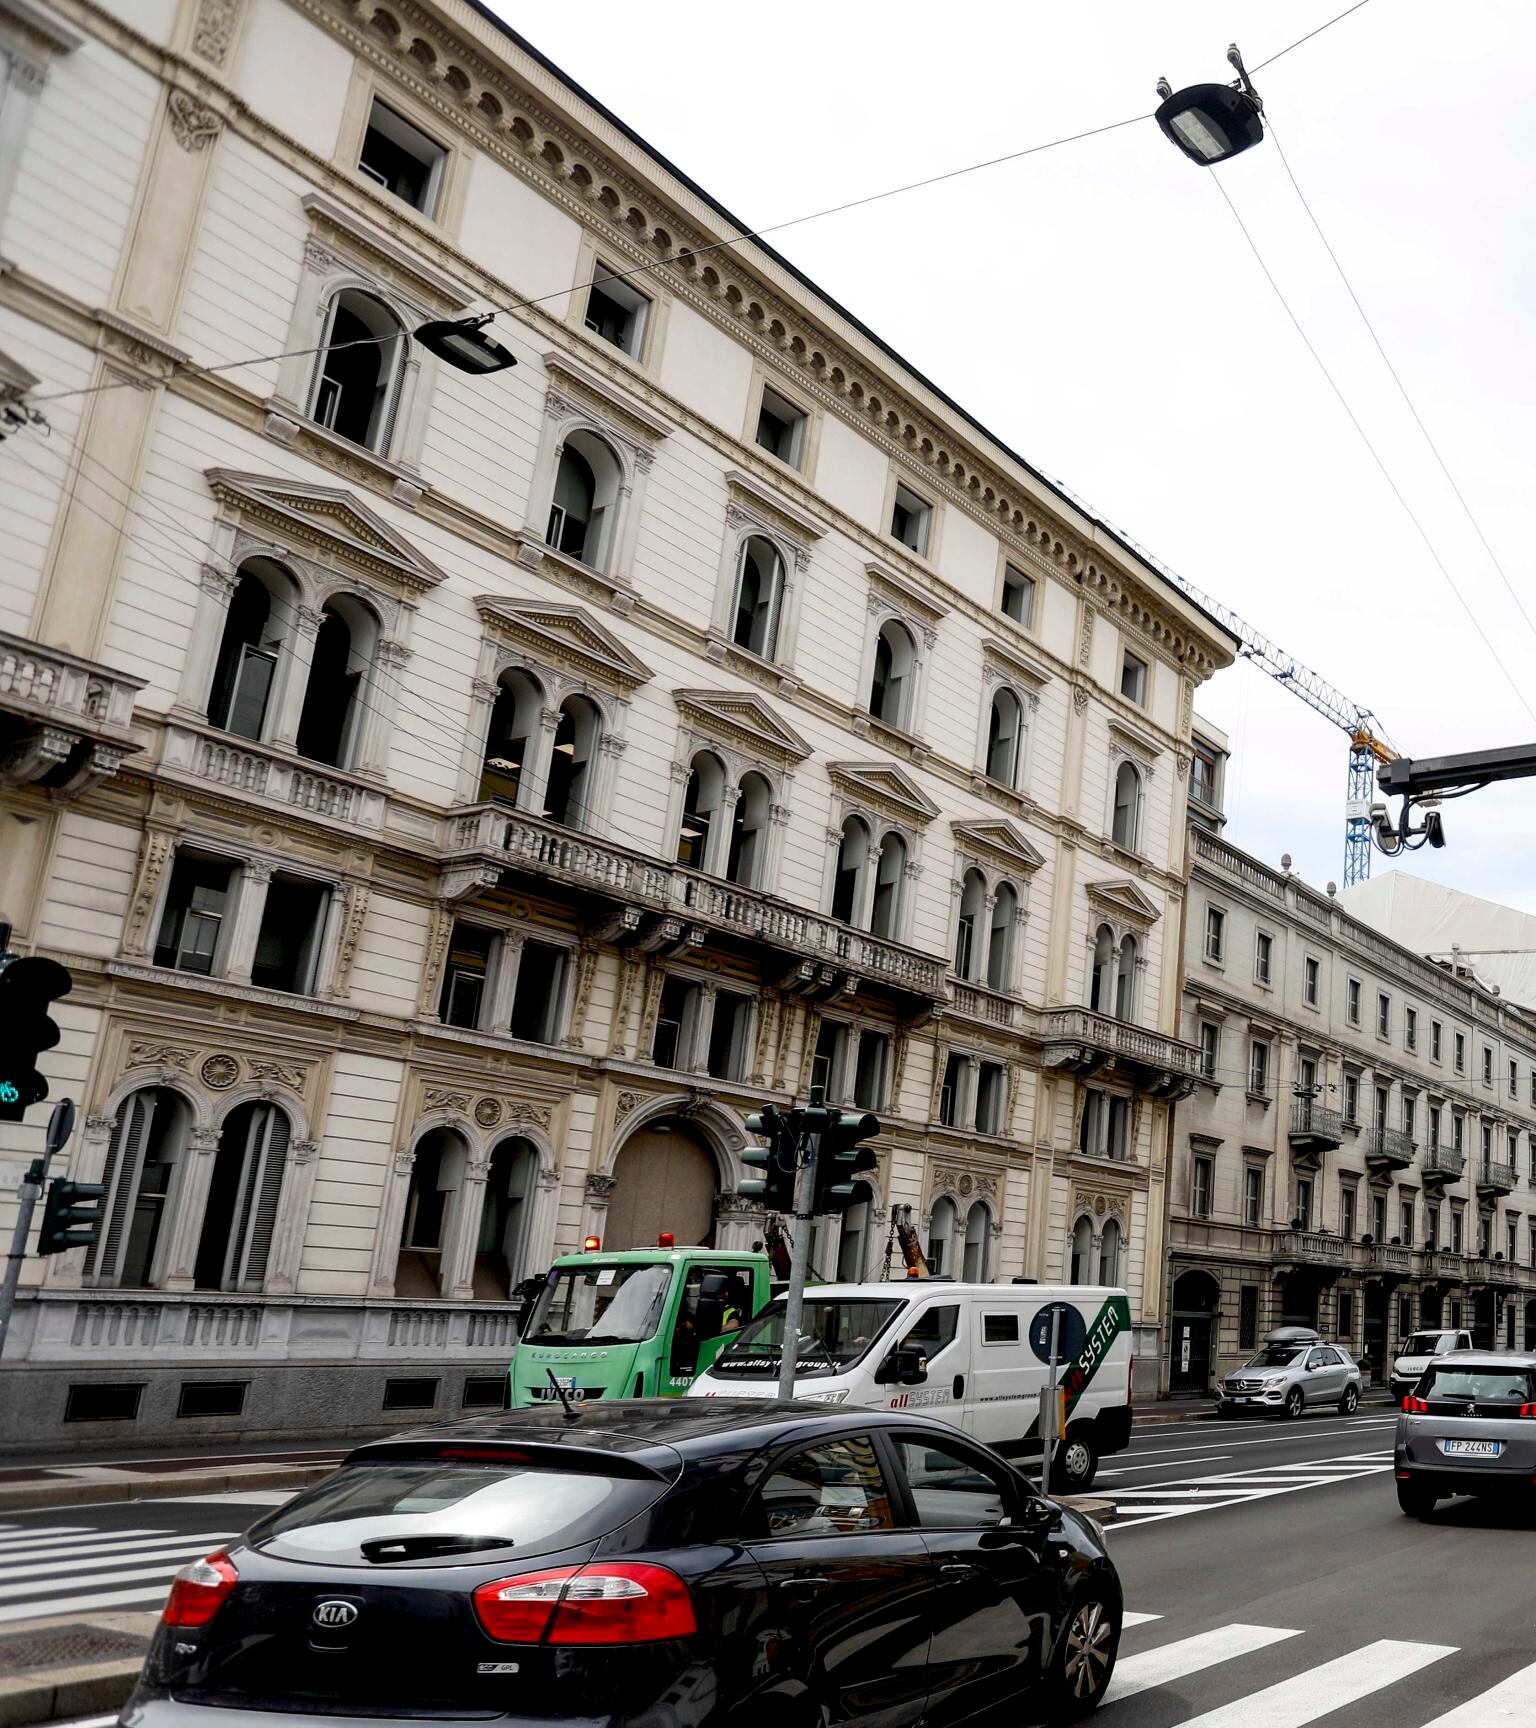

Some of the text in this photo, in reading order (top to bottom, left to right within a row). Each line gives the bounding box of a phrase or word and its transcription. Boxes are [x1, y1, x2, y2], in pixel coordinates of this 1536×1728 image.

[532, 1351, 608, 1359] EUROCARGO
[669, 1376, 694, 1387] 4407
[1451, 1441, 1493, 1453] FP 244NS
[318, 1606, 348, 1622] KIA
